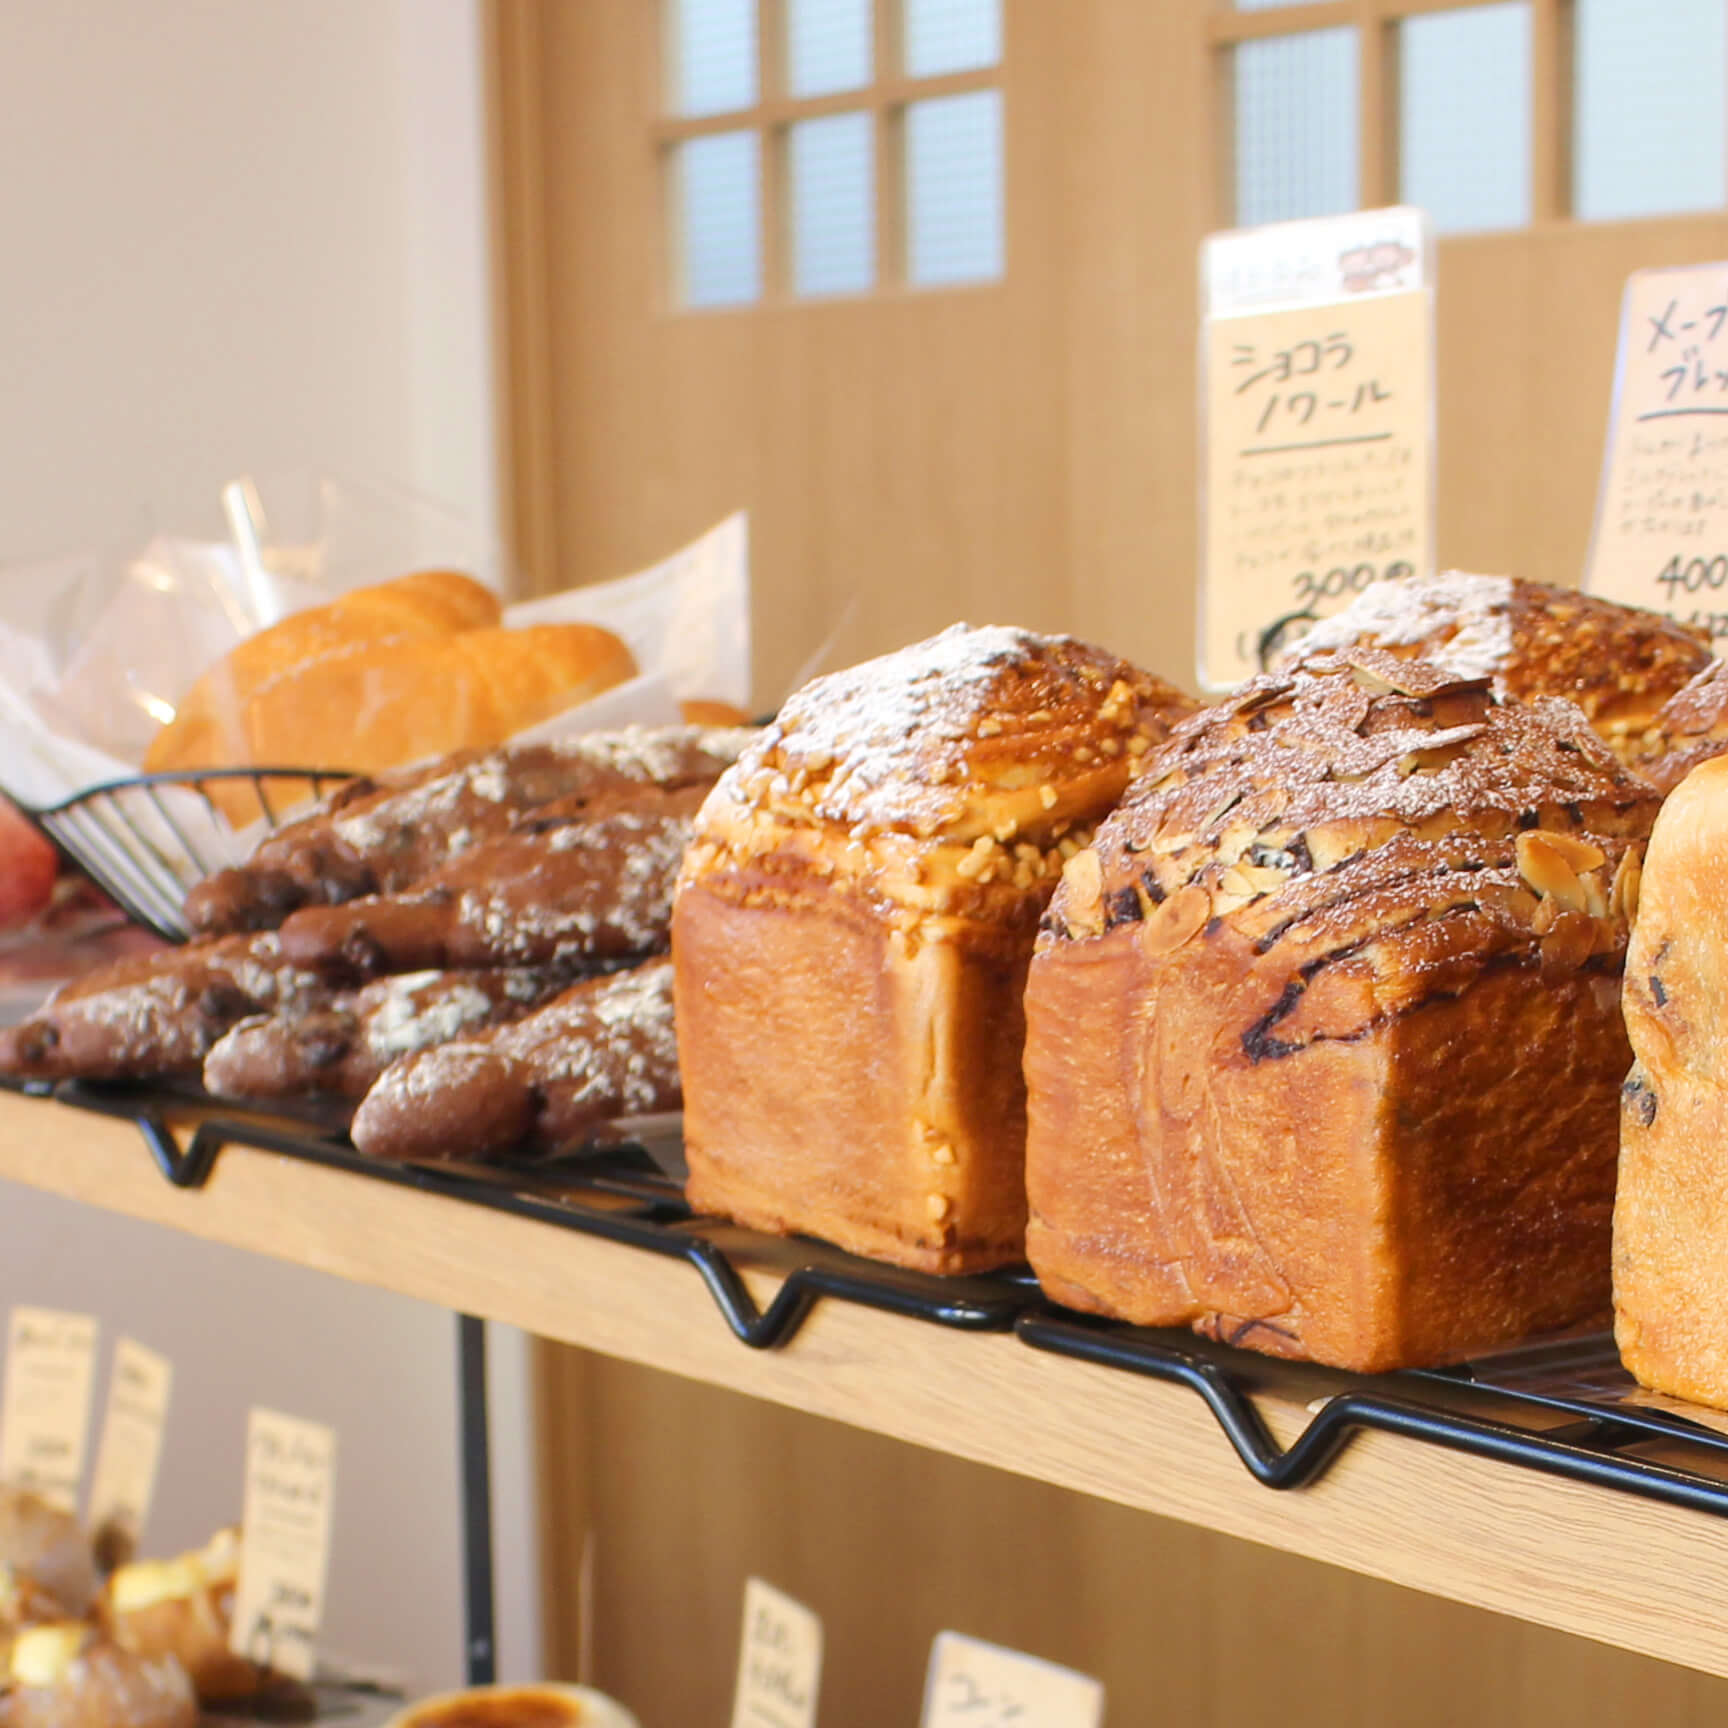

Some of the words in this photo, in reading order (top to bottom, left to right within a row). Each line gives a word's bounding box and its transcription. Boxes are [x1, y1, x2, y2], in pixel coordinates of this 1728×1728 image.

[1230, 331, 1355, 395] ショコラ
[1255, 379, 1394, 435] ノワール
